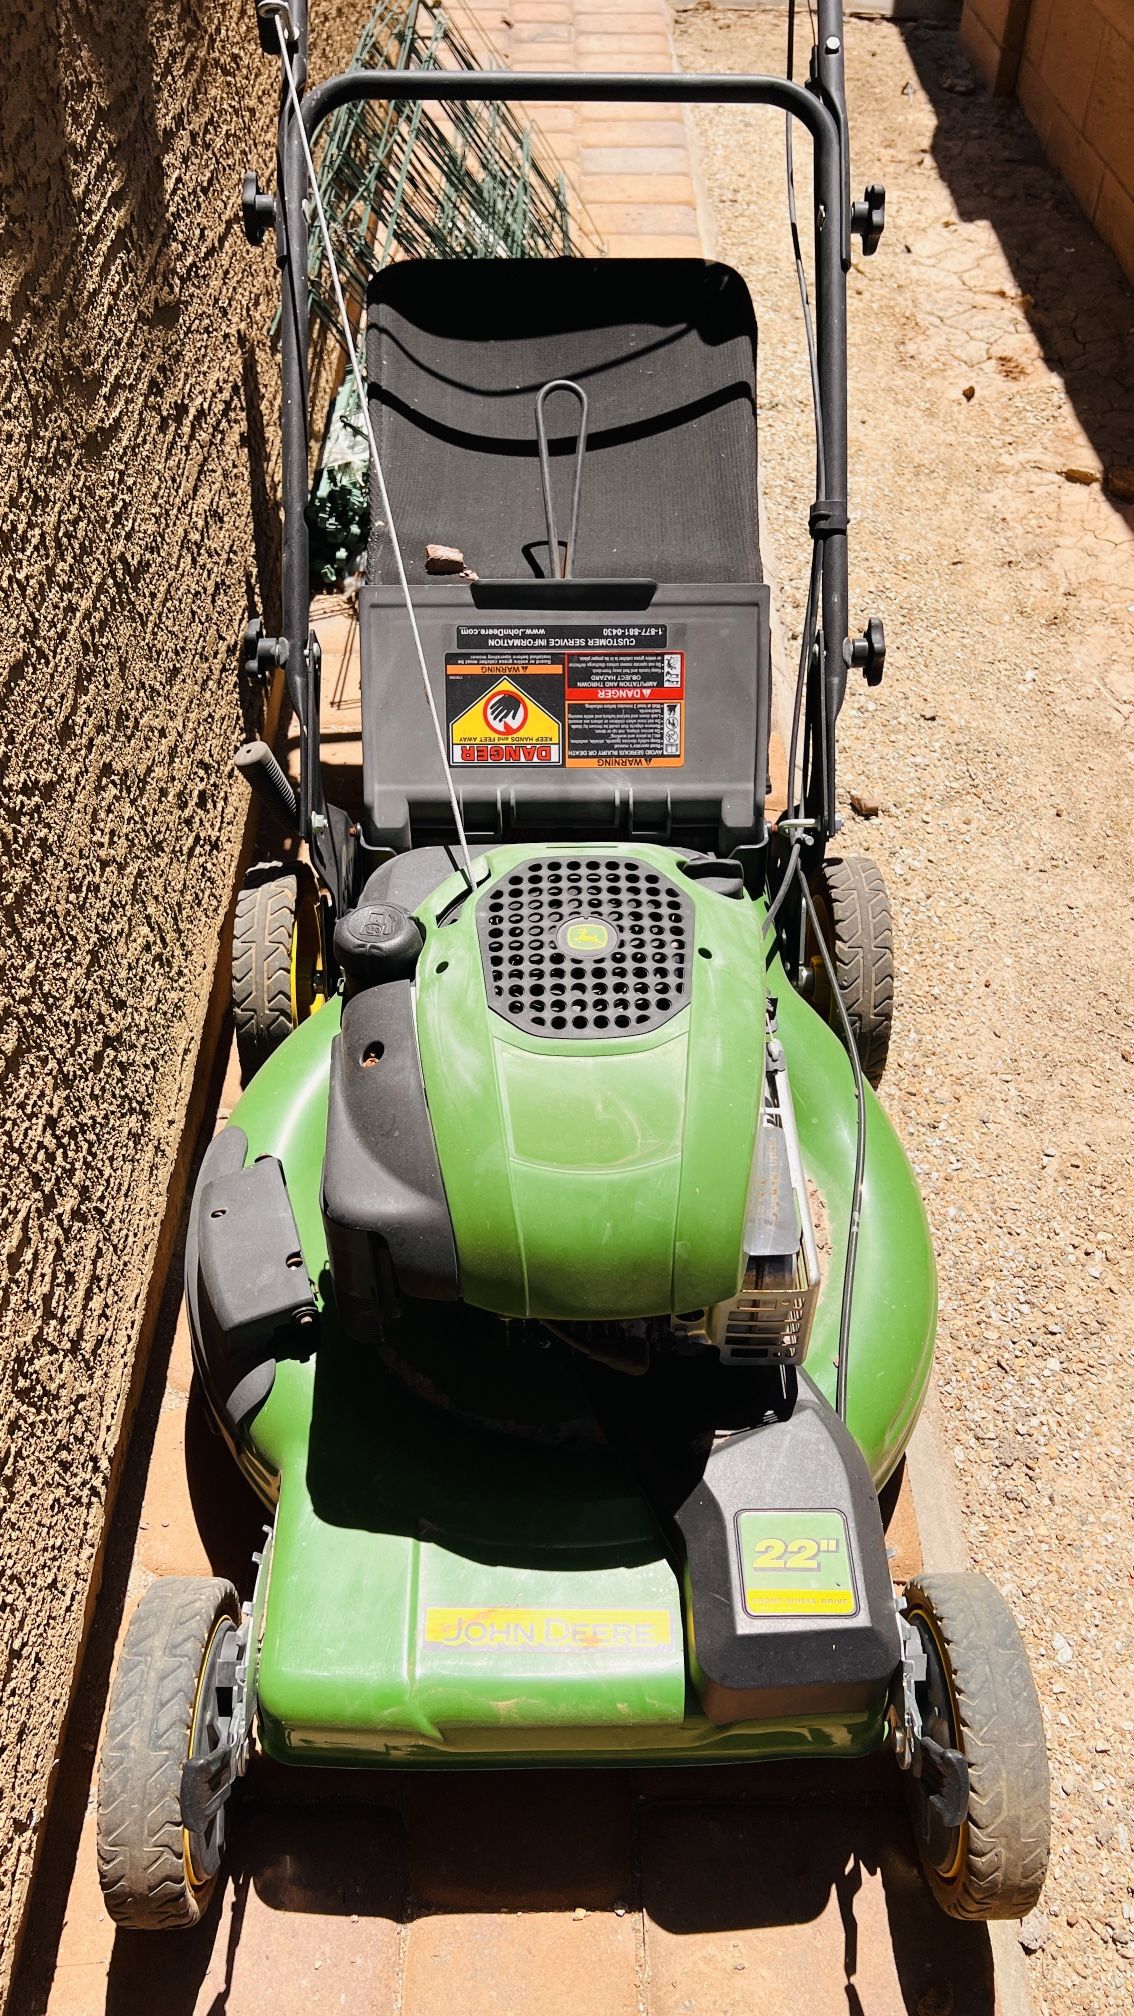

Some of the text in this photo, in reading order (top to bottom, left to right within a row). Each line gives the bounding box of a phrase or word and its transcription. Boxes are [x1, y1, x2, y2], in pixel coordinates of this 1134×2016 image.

[598, 690, 640, 698] DANGER
[461, 746, 551, 761] DANGER
[752, 1537, 839, 1571] 22"
[444, 1617, 655, 1644] JOHN DEERE
